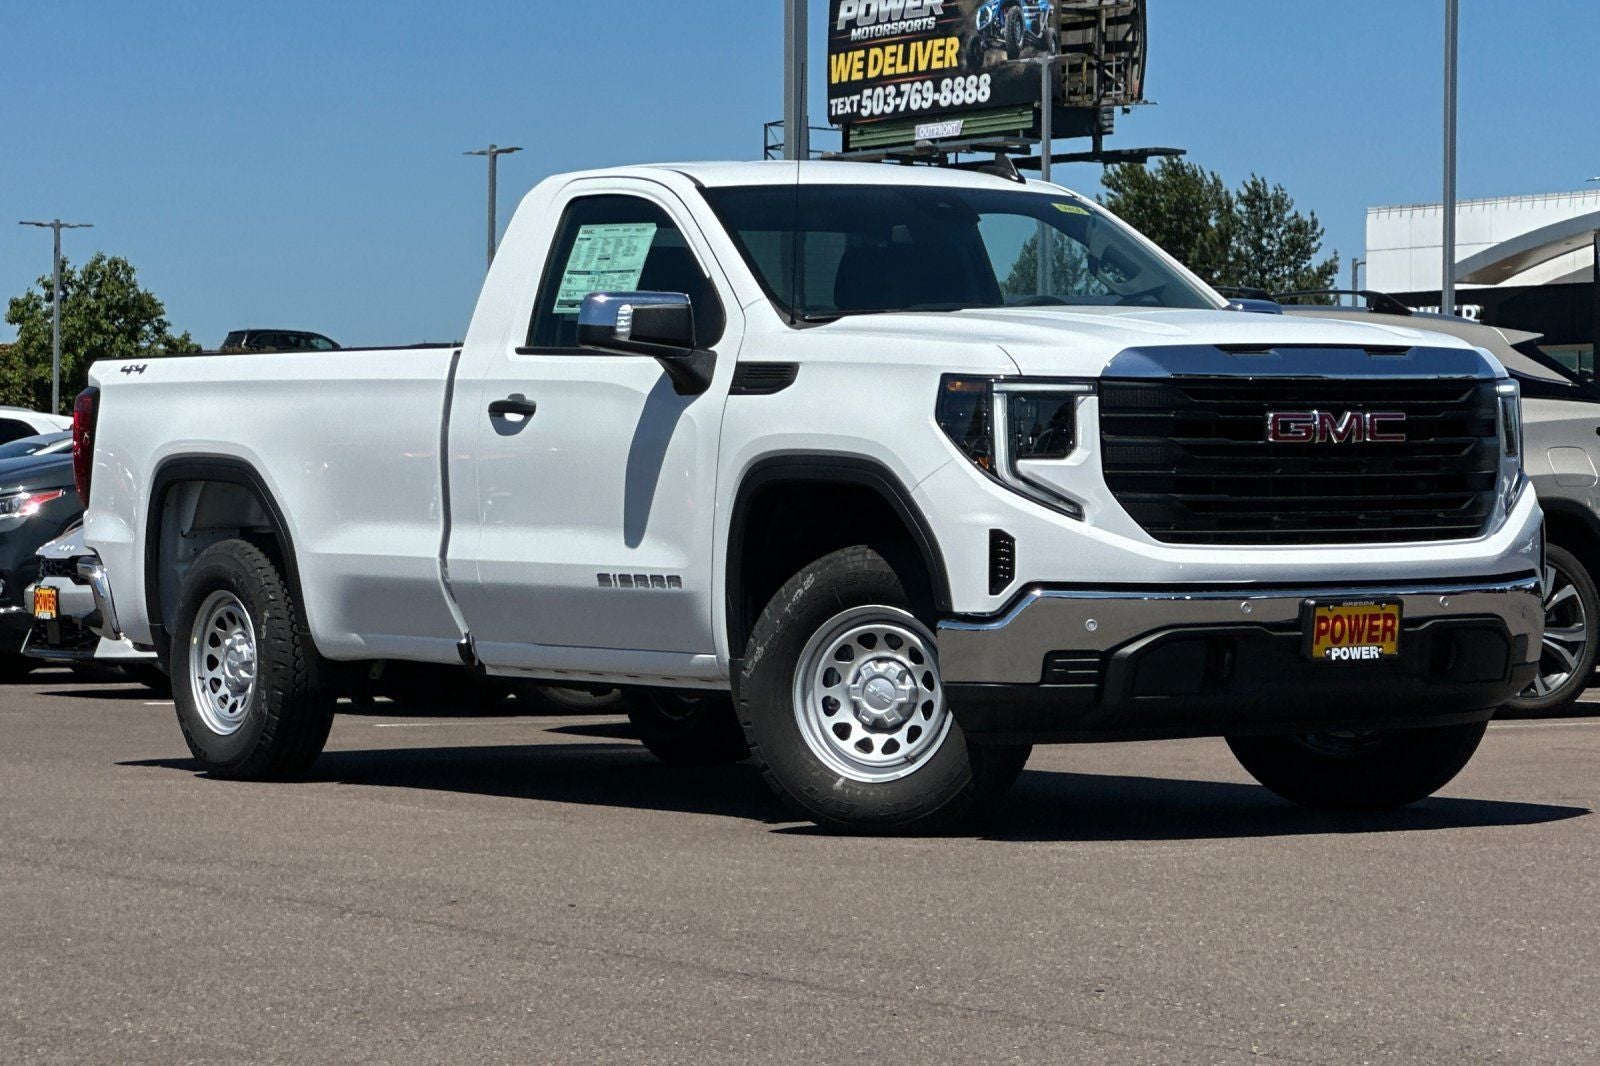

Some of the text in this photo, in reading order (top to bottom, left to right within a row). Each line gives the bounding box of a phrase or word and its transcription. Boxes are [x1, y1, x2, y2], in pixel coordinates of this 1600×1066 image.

[851, 17, 936, 41] MOTORSPORTS
[831, 37, 960, 84] WE DELIVER
[830, 73, 991, 117] TEXT 503-769-8888
[918, 123, 963, 138] OUTFRONT
[1266, 410, 1406, 443] GMC
[597, 573, 683, 589] SIERRA
[1315, 613, 1397, 645] POWER
[1331, 645, 1379, 661] POWER
